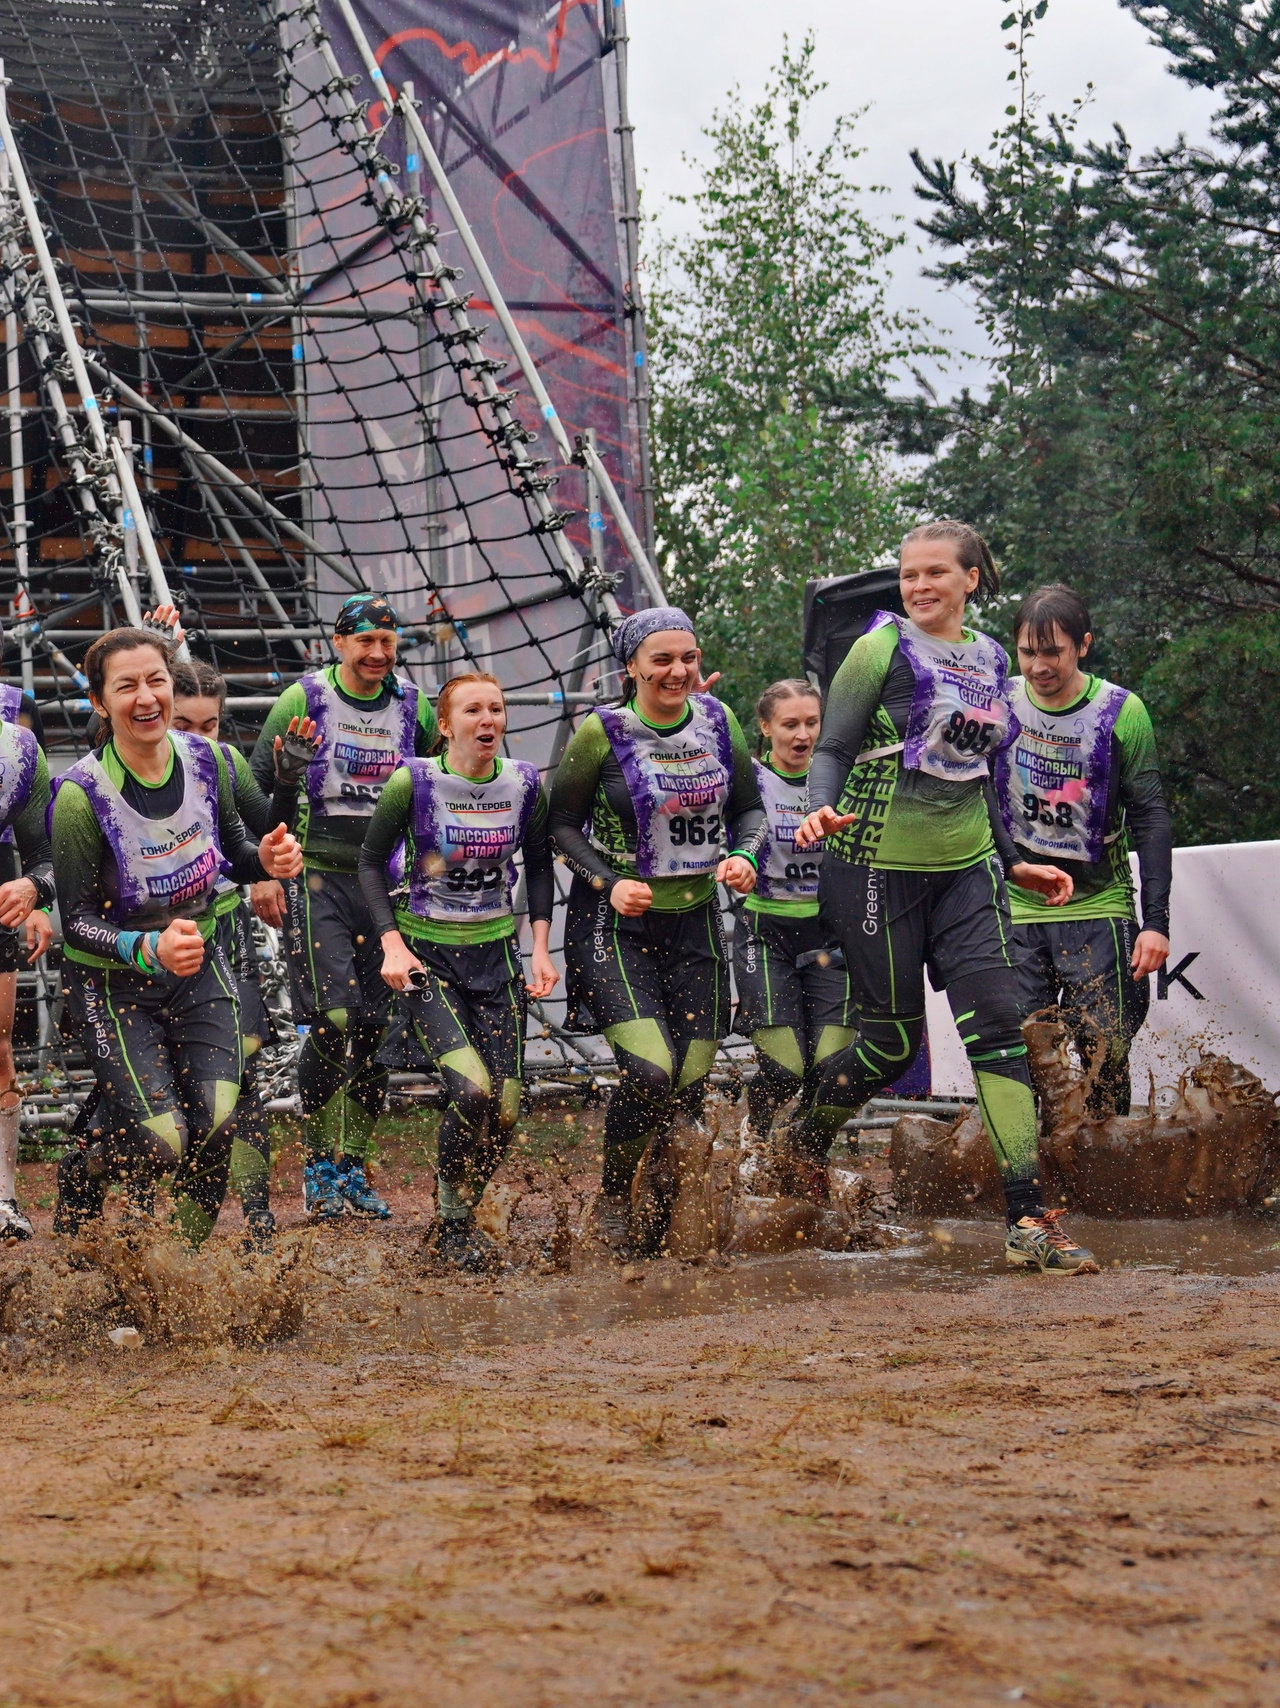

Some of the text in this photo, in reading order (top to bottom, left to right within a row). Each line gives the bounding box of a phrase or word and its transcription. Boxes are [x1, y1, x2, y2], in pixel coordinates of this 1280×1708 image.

[977, 650, 987, 666] 5
[960, 688, 992, 709] СТАРТ
[338, 722, 391, 735] ГОНКА ГЕРОЕВ
[943, 710, 996, 755] 995
[1046, 733, 1081, 744] ГЕРОЕВ
[337, 745, 393, 764] МАССОВЫЙ
[649, 747, 708, 761] ГОНКА ГЕРО
[349, 762, 379, 776] СТАРТ
[1018, 750, 1080, 777] МАССОВЫЙ
[1031, 772, 1062, 789] СТАРТ
[445, 800, 512, 811] ГОНКА ГЕРОЕВ
[680, 790, 714, 806] СТАРТ
[775, 803, 802, 812] ГОНКА
[1023, 793, 1073, 828] 958
[140, 821, 201, 856] ГОНКА ЕРОЕВ
[448, 826, 514, 844] МАССОВЫЙ
[669, 814, 721, 846] 962
[466, 845, 500, 858] СТАРТ
[150, 850, 215, 895] МАССОВЫЙ
[171, 879, 205, 905] СТАРТ
